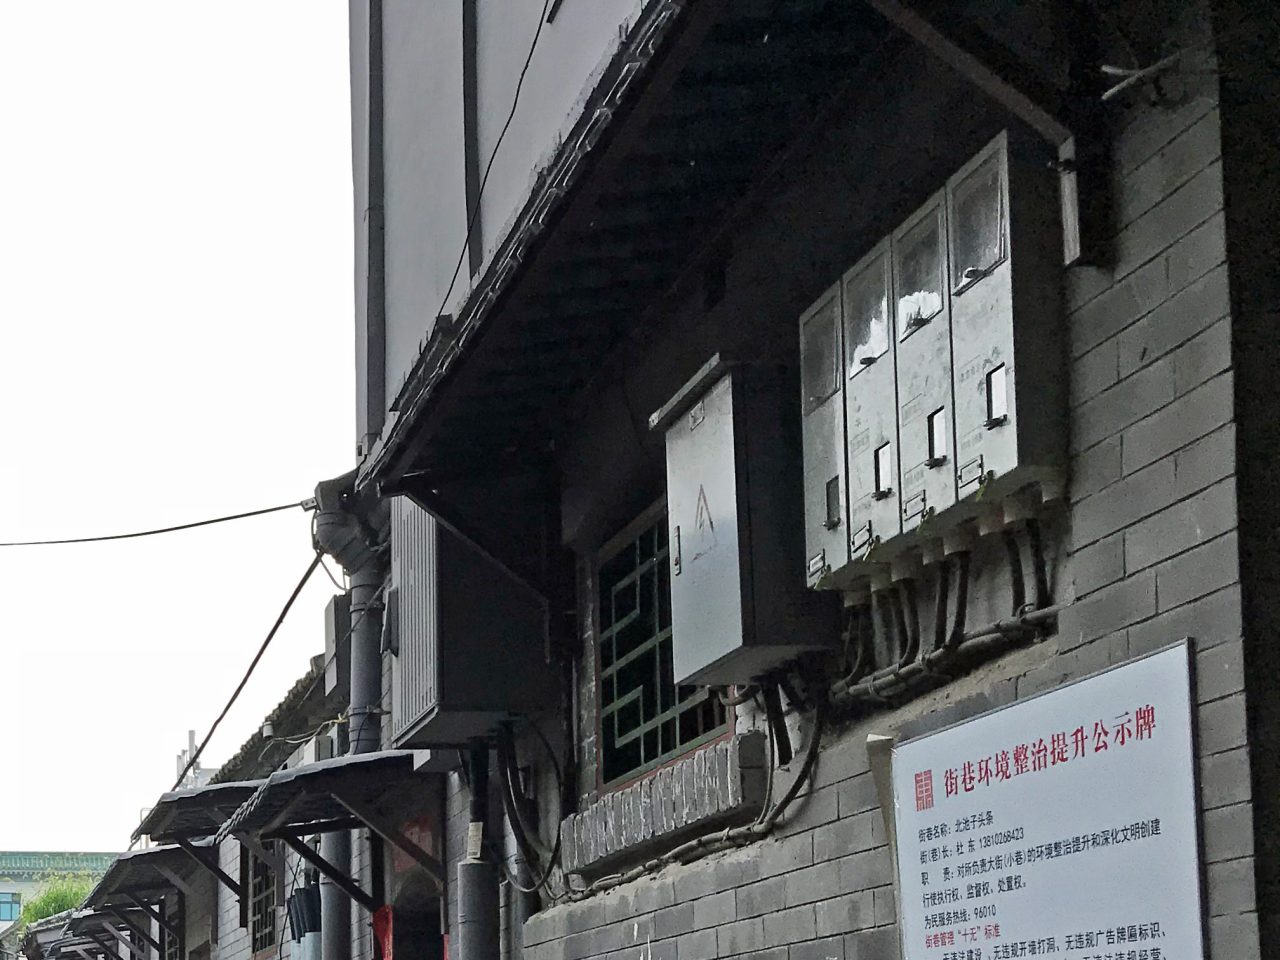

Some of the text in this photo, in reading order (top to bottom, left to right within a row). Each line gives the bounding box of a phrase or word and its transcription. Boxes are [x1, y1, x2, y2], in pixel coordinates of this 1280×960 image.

[944, 704, 1156, 798] 街巷环境整治提升公示牌
[918, 810, 994, 843] 街巷名称：北池子头条
[924, 904, 997, 930] 为民服务热线：96010
